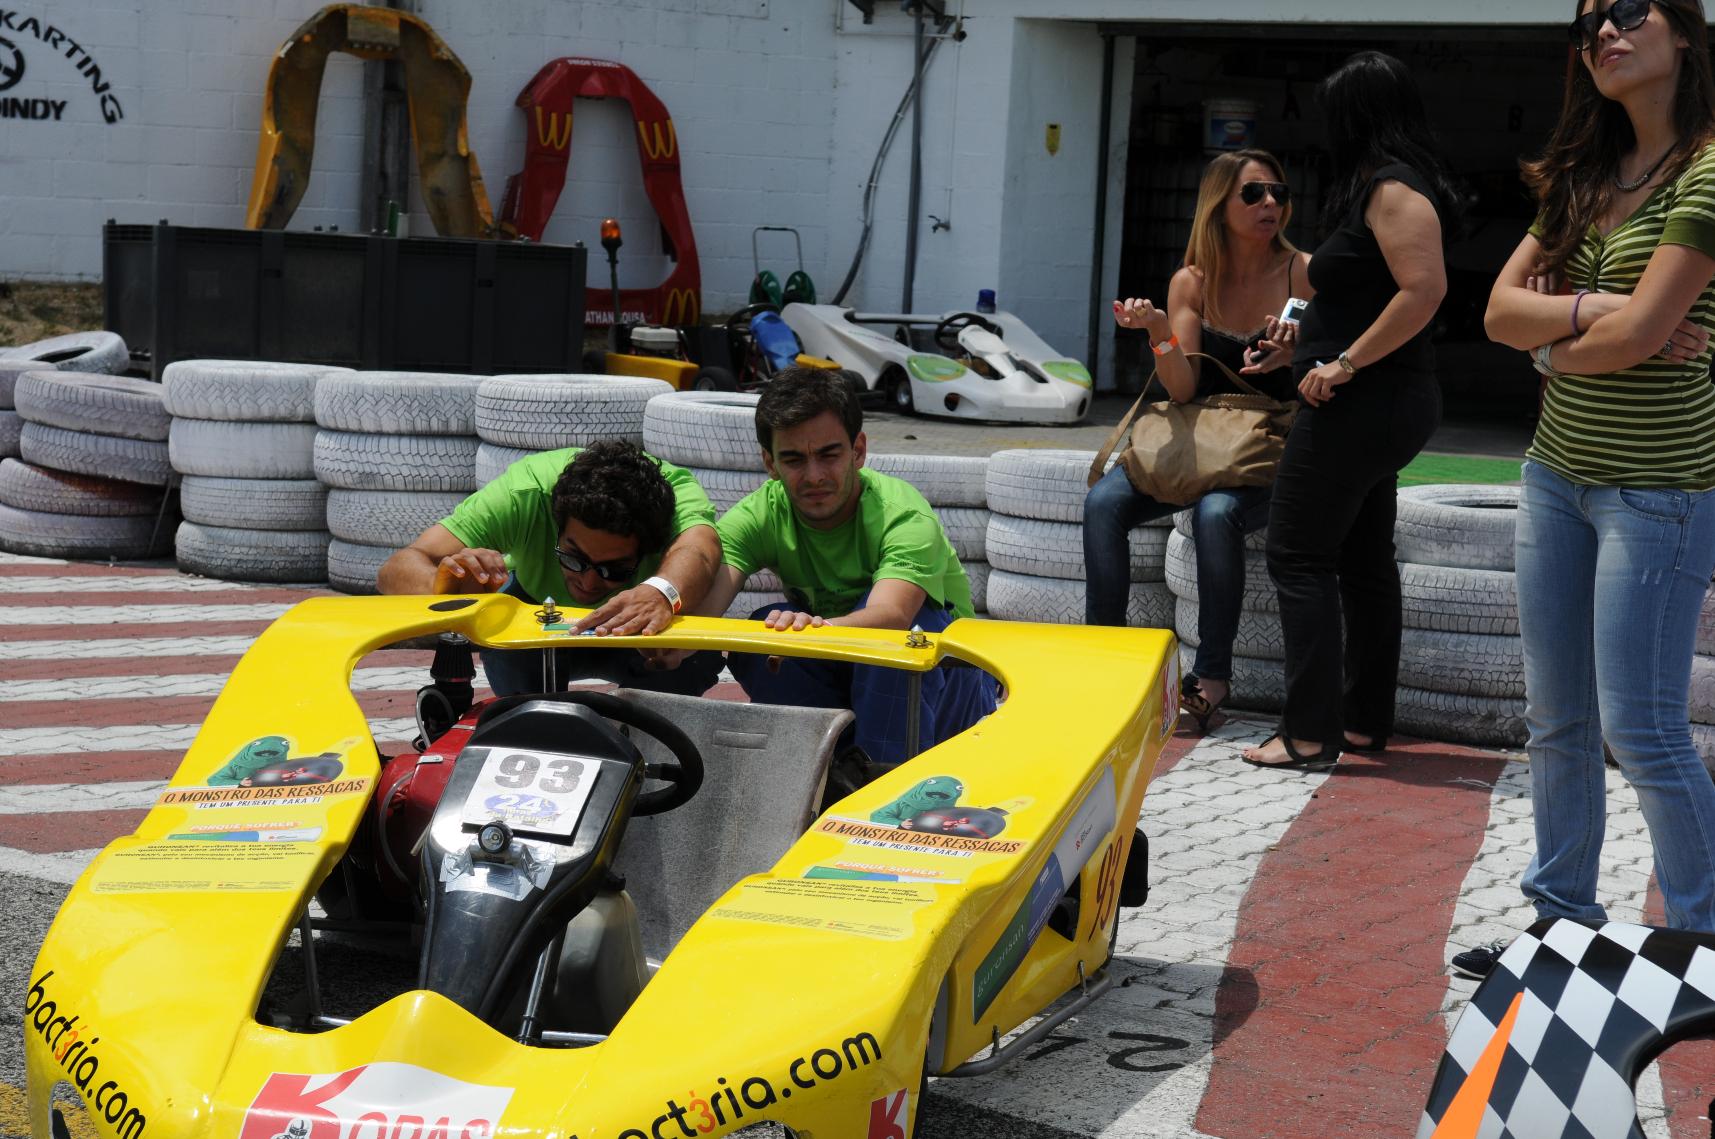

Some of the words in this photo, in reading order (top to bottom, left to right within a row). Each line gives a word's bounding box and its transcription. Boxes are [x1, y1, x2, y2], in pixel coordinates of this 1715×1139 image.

[0, 9, 123, 124] KARTING
[494, 754, 585, 794] 93
[164, 793, 175, 804] O
[179, 788, 251, 803] MONSTRO
[254, 787, 284, 799] DAS
[287, 779, 365, 798] RESSACAS
[236, 798, 279, 807] PRESENTE
[282, 796, 306, 804] PARA
[822, 821, 834, 832] O
[836, 823, 908, 842] MONSTRO
[908, 834, 942, 846] DAS
[944, 837, 1020, 853] RESSACAS
[889, 843, 929, 853] PRESENTE
[932, 848, 958, 856] PARA
[1088, 835, 1123, 943] 93
